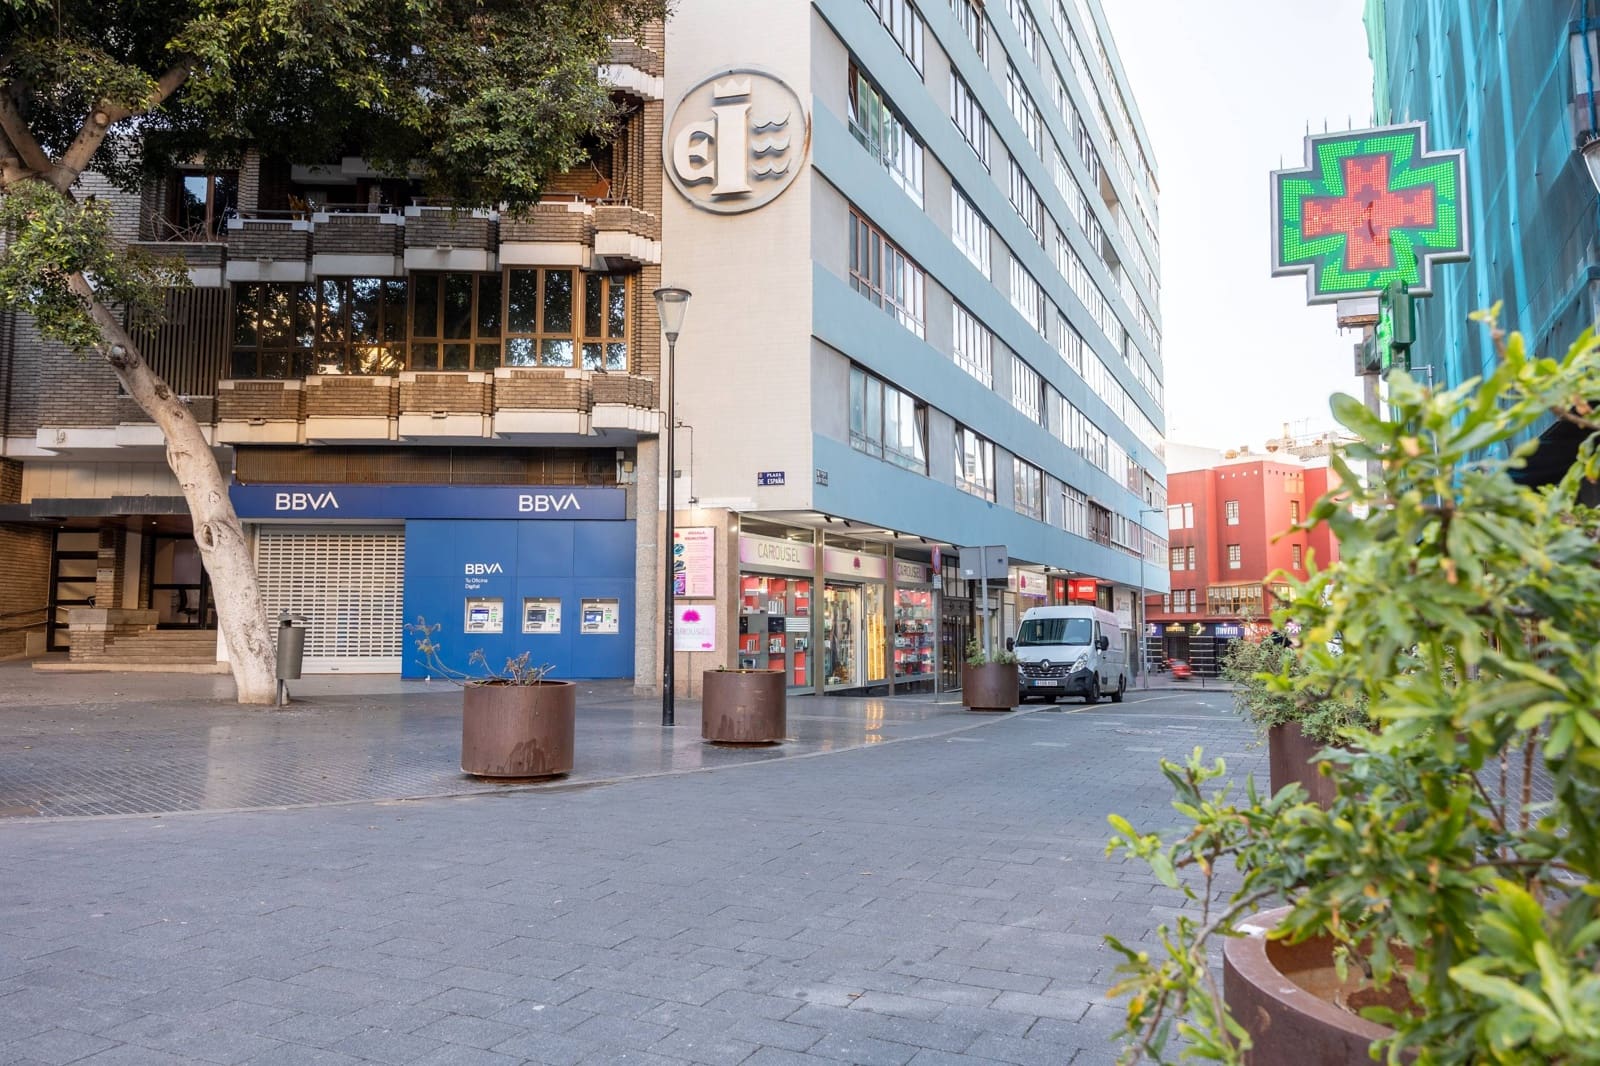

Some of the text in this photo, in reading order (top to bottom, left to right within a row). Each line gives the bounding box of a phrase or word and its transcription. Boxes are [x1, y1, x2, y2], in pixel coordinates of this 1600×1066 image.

[275, 491, 339, 511] BBVA
[518, 493, 581, 513] BBVA
[758, 543, 800, 563] CAROUSEL
[465, 562, 503, 575] BBVA
[897, 563, 922, 579] CAROUSEL
